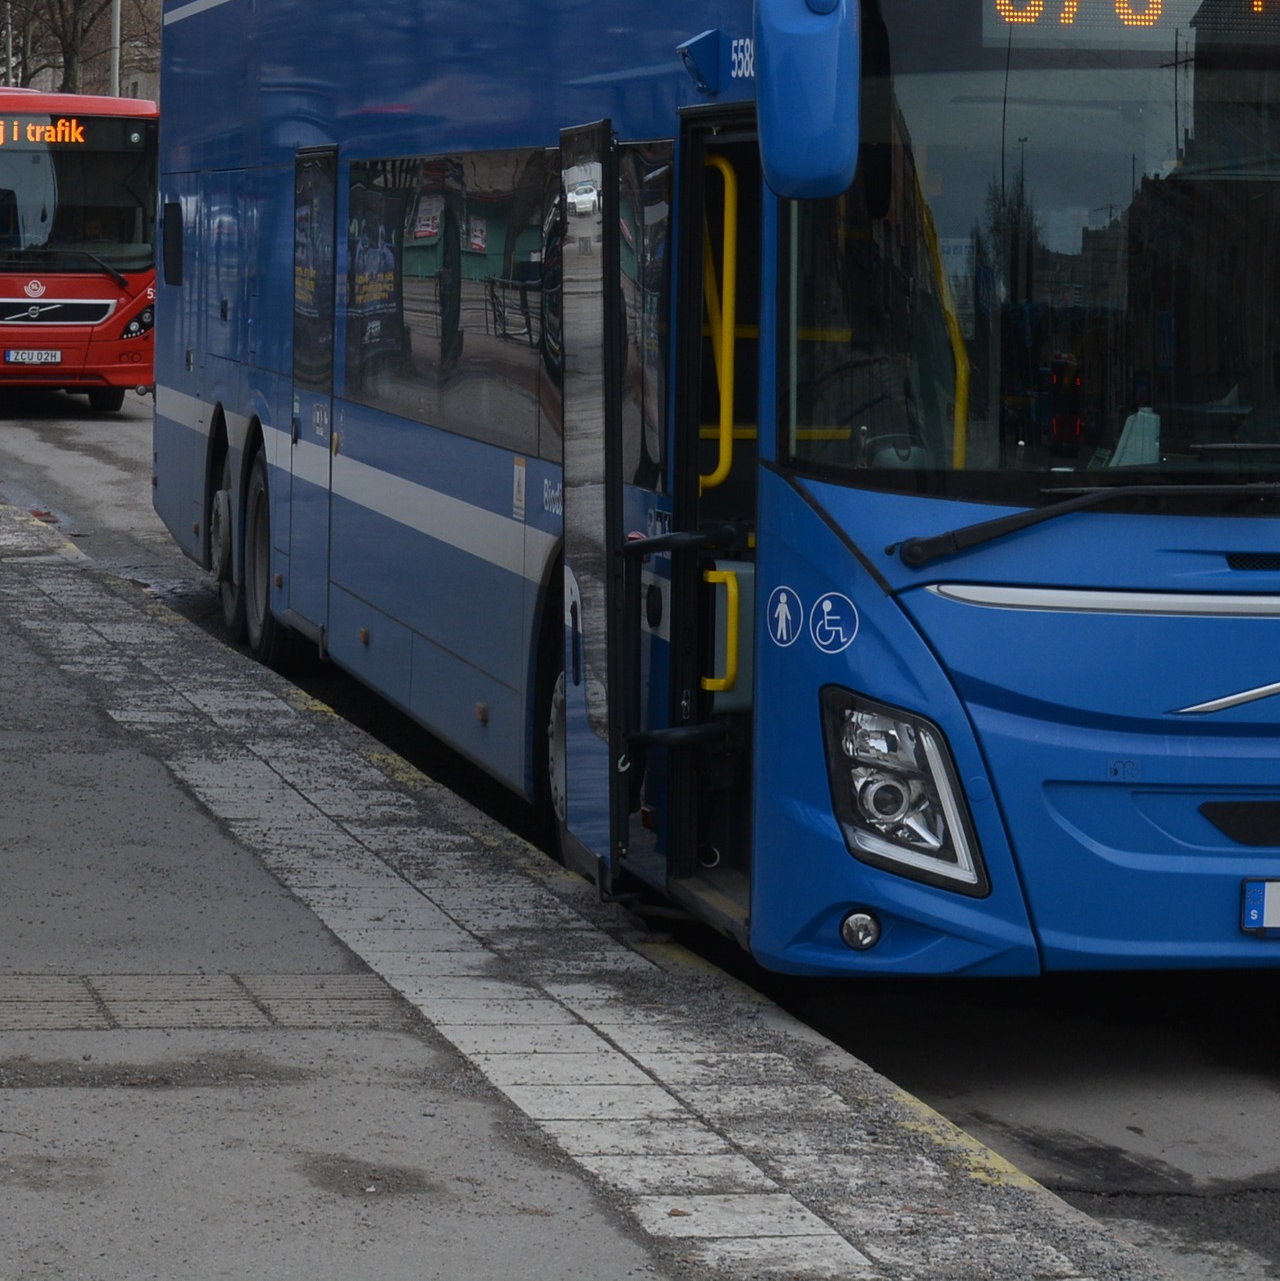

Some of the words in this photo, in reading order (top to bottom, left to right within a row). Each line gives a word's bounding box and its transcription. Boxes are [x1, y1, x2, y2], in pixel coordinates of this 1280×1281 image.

[13, 121, 18, 141] i
[26, 119, 85, 142] trafik
[14, 351, 34, 360] ZCU
[1250, 909, 1258, 920] S
